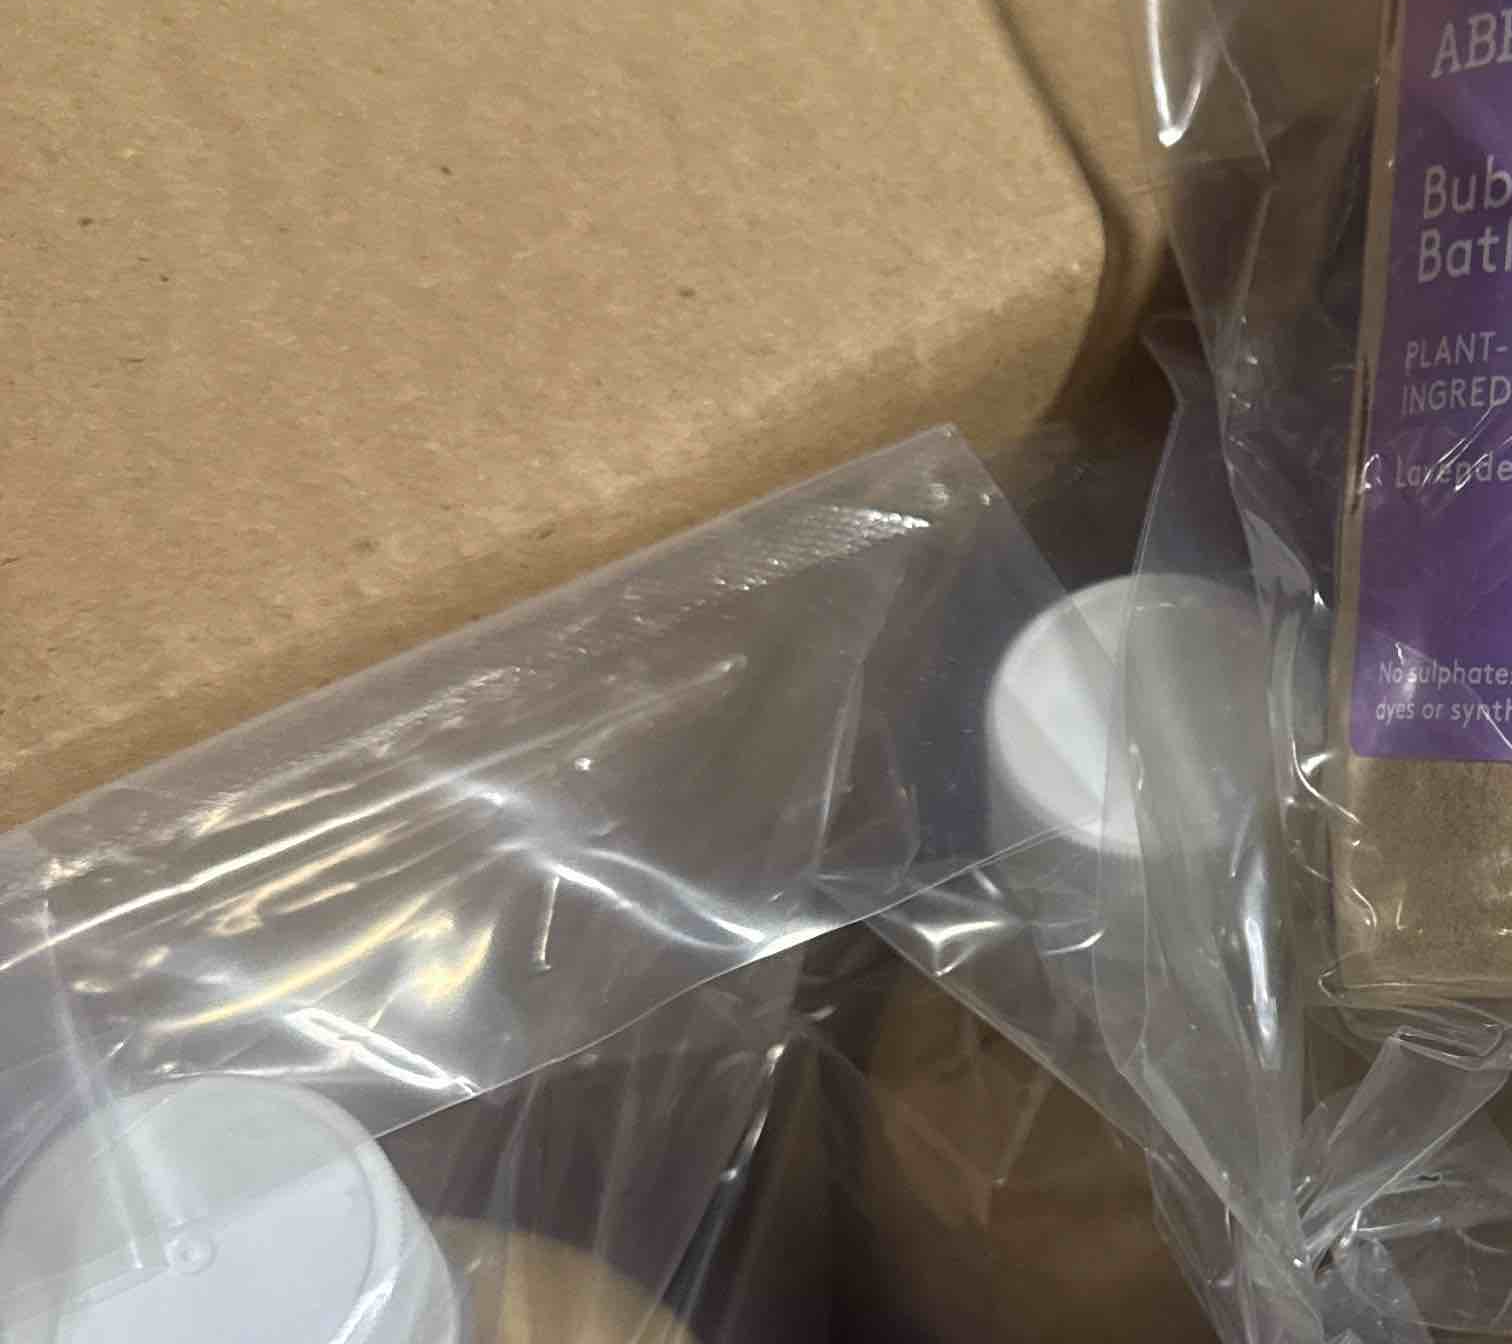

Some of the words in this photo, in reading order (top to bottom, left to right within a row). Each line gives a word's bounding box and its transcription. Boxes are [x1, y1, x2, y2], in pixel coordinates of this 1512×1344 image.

[1378, 661, 1403, 685] No
[1375, 699, 1415, 725] dyes
[1422, 703, 1444, 720] or
